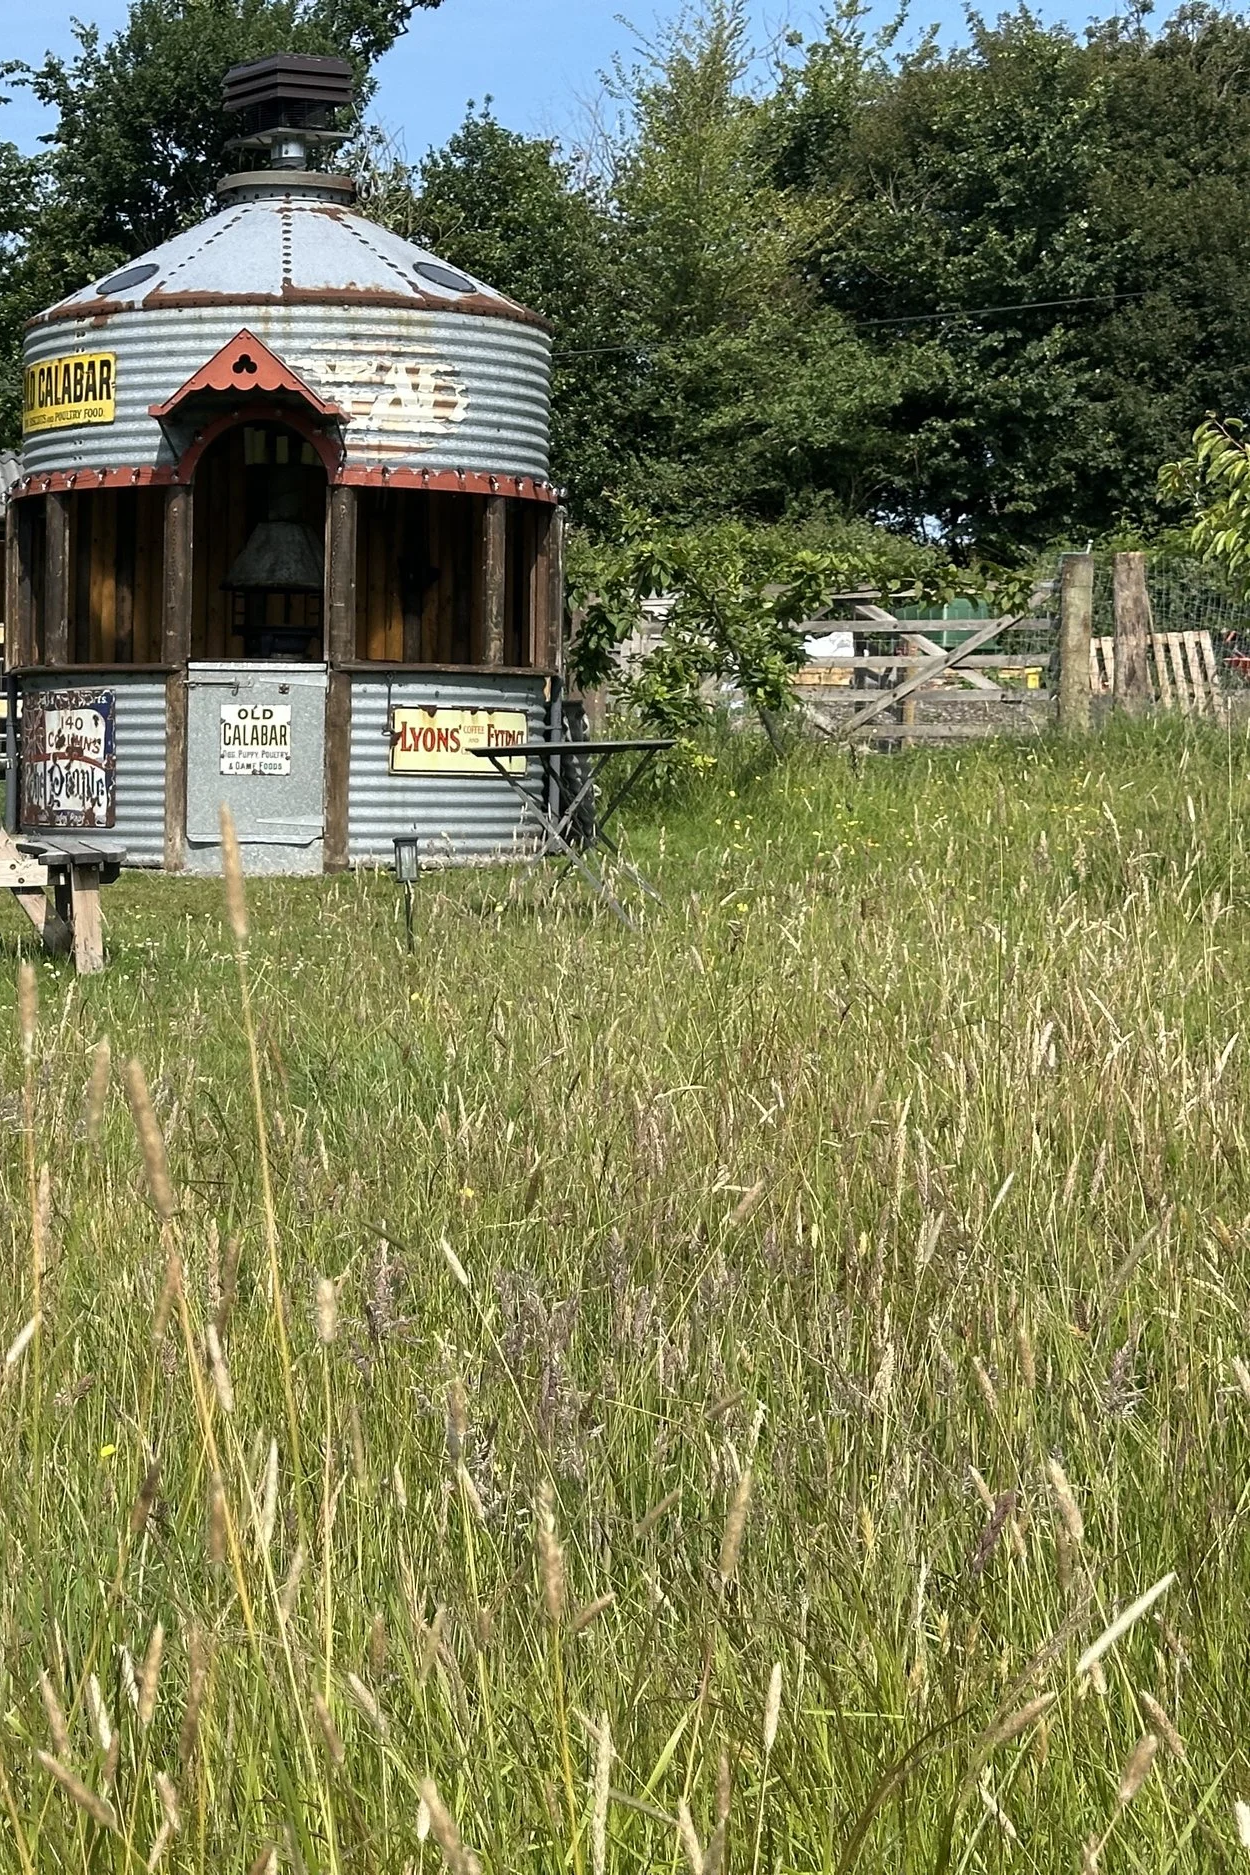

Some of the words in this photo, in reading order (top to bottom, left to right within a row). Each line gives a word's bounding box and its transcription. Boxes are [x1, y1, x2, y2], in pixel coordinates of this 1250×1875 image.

[38, 359, 112, 408] CALABAR
[54, 409, 82, 422] POULTRY
[237, 708, 274, 720] OLD
[61, 715, 84, 731] 140
[223, 722, 288, 746] CALABAR
[463, 725, 485, 735] COFFEE
[235, 761, 257, 770] GAME
[259, 762, 283, 770] FOODS
